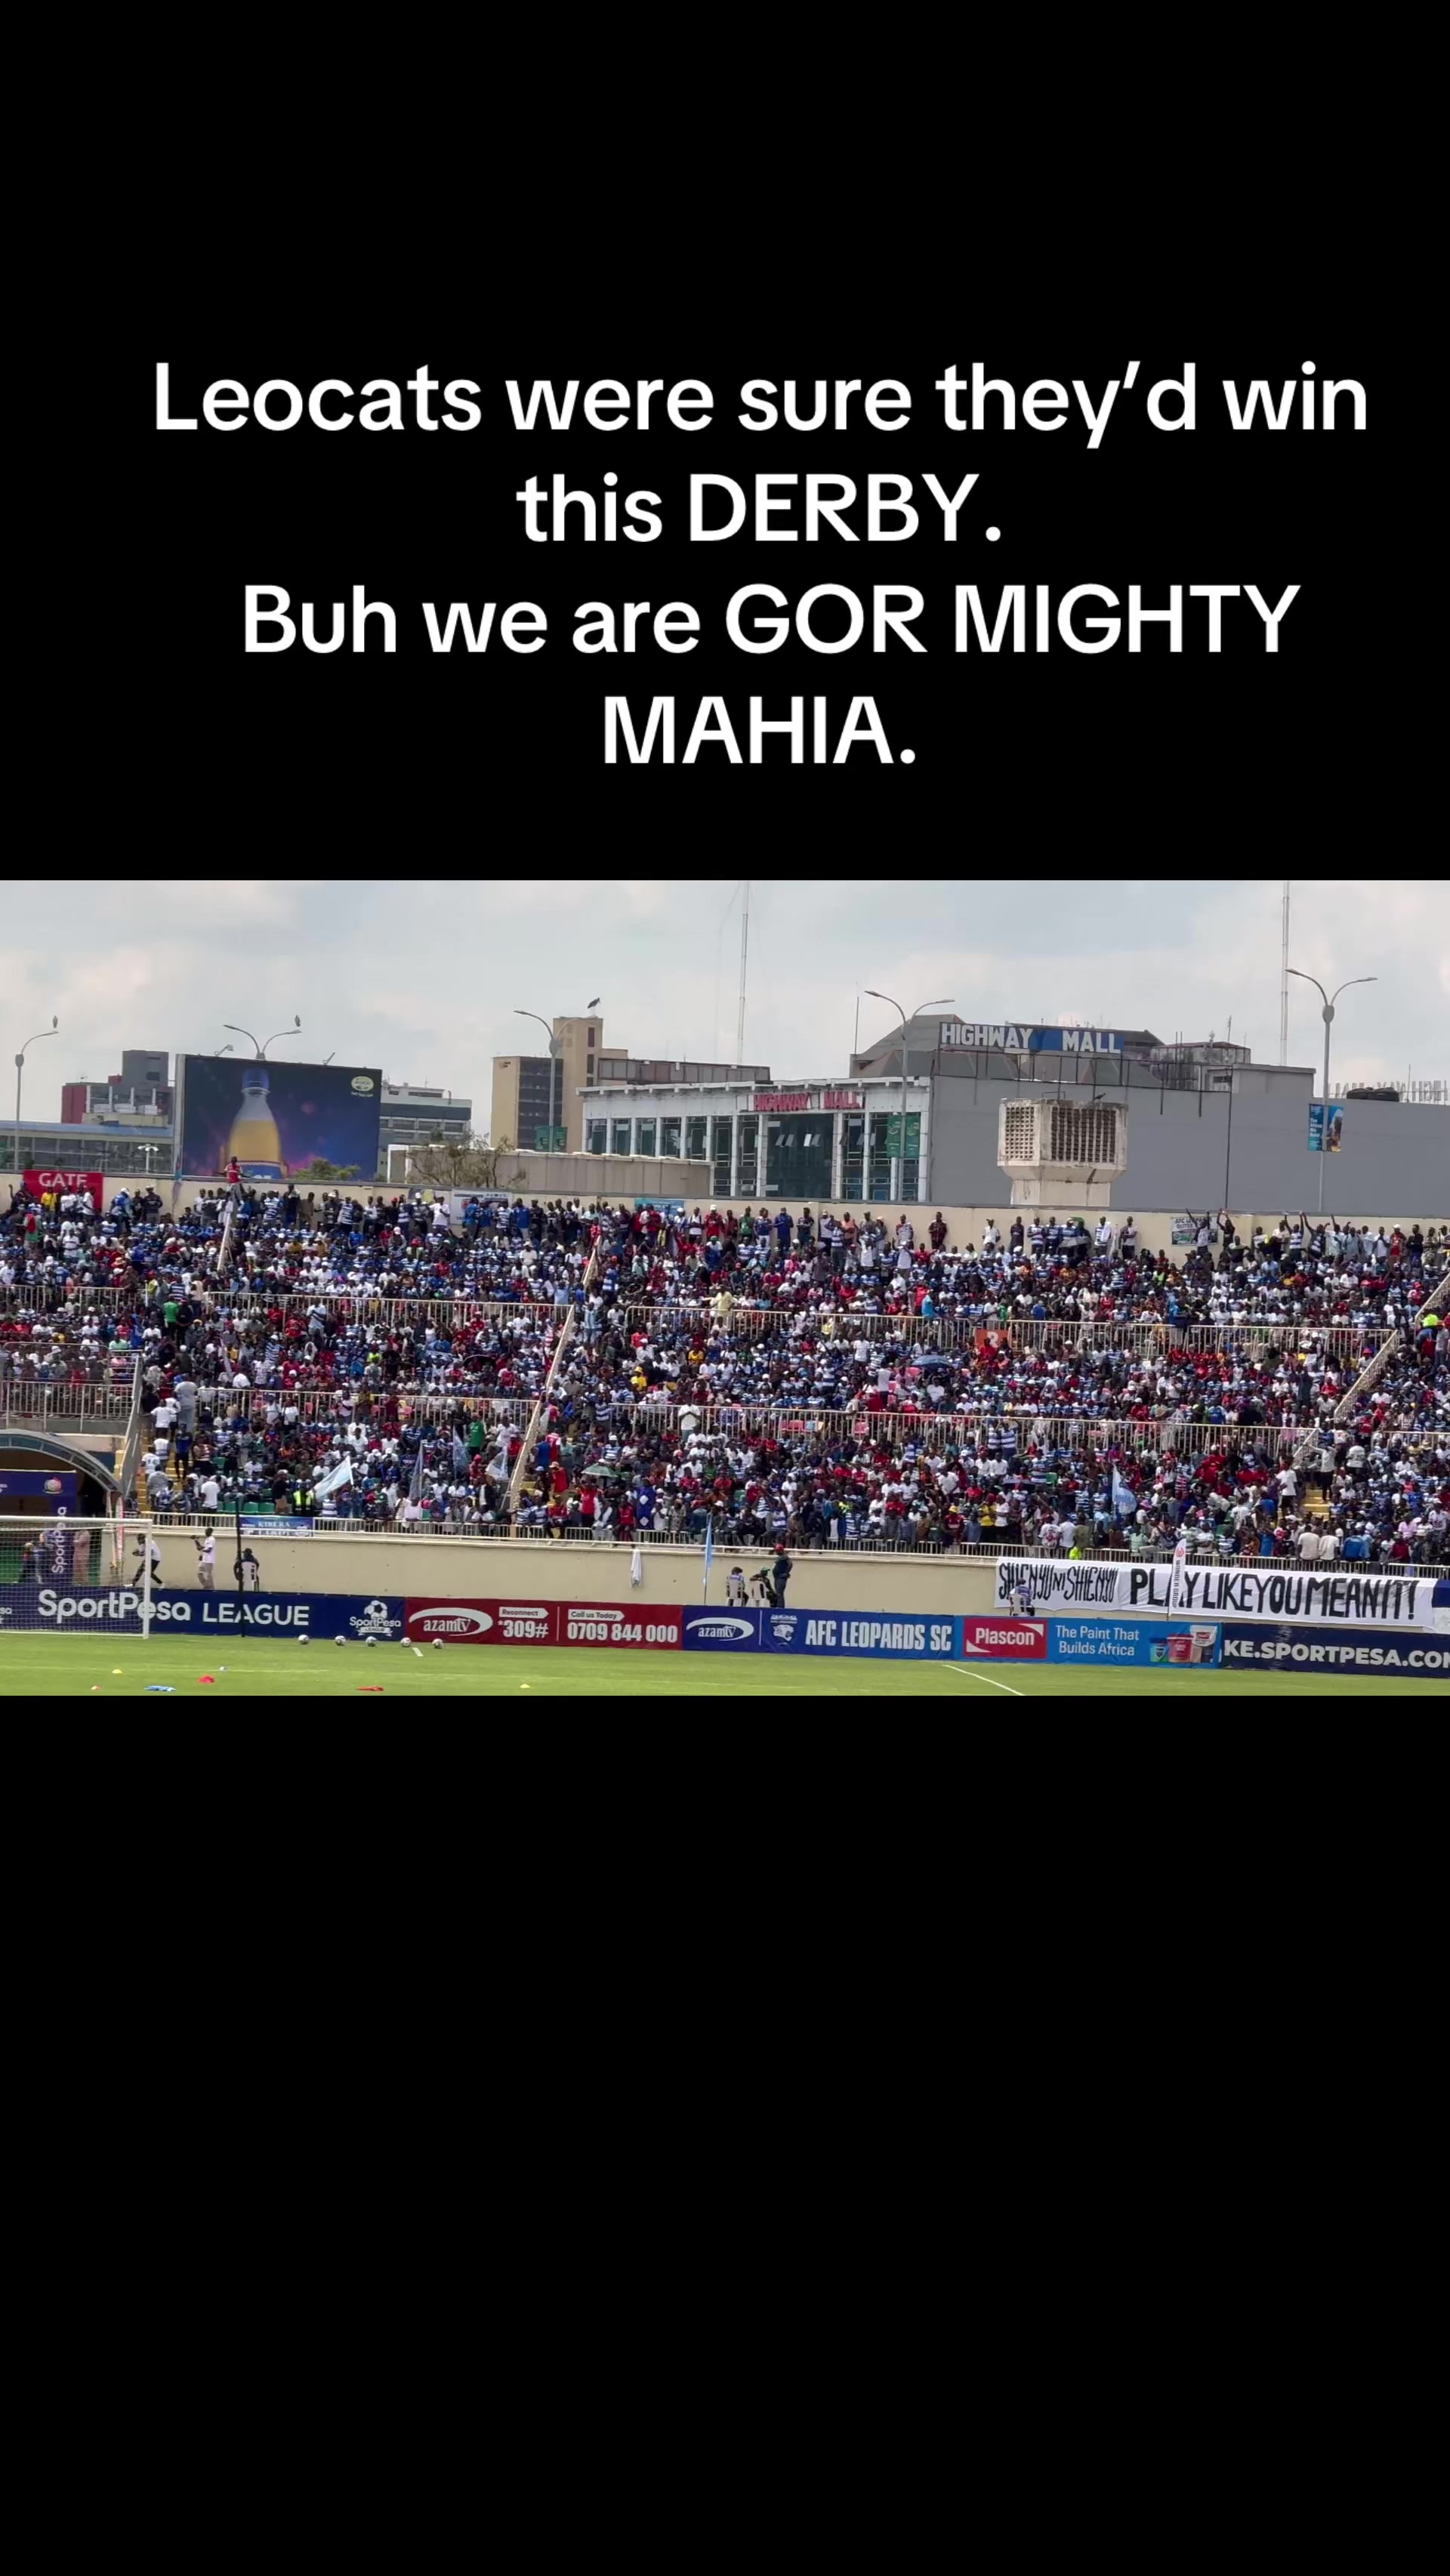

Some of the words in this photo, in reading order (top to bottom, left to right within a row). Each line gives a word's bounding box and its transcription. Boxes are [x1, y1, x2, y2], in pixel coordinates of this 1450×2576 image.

[941, 1022, 1033, 1049] HIGHWAY
[1062, 1030, 1121, 1054] MALL
[755, 1092, 809, 1111] HIGHWAY
[823, 1090, 860, 1109] MALL
[39, 1172, 87, 1188] GATE
[51, 1506, 68, 1573] SportPea
[38, 1588, 192, 1623] SportPesa
[202, 1602, 310, 1625] LEAGUE
[501, 1608, 538, 1616] Reconnect
[596, 1612, 618, 1620] Today
[349, 1616, 401, 1628] SportPesa
[567, 1622, 607, 1640] 0709
[611, 1623, 643, 1642] 844
[646, 1625, 678, 1644] 000
[805, 1619, 837, 1646] AFC
[841, 1621, 926, 1650] LEOPARDS
[930, 1625, 952, 1651] SC
[975, 1627, 1035, 1646] Plascon
[1056, 1625, 1077, 1638] The
[1080, 1625, 1109, 1640] Paint
[1114, 1627, 1140, 1641] That
[1058, 1641, 1095, 1654] Builds
[1097, 1642, 1135, 1656] Africa
